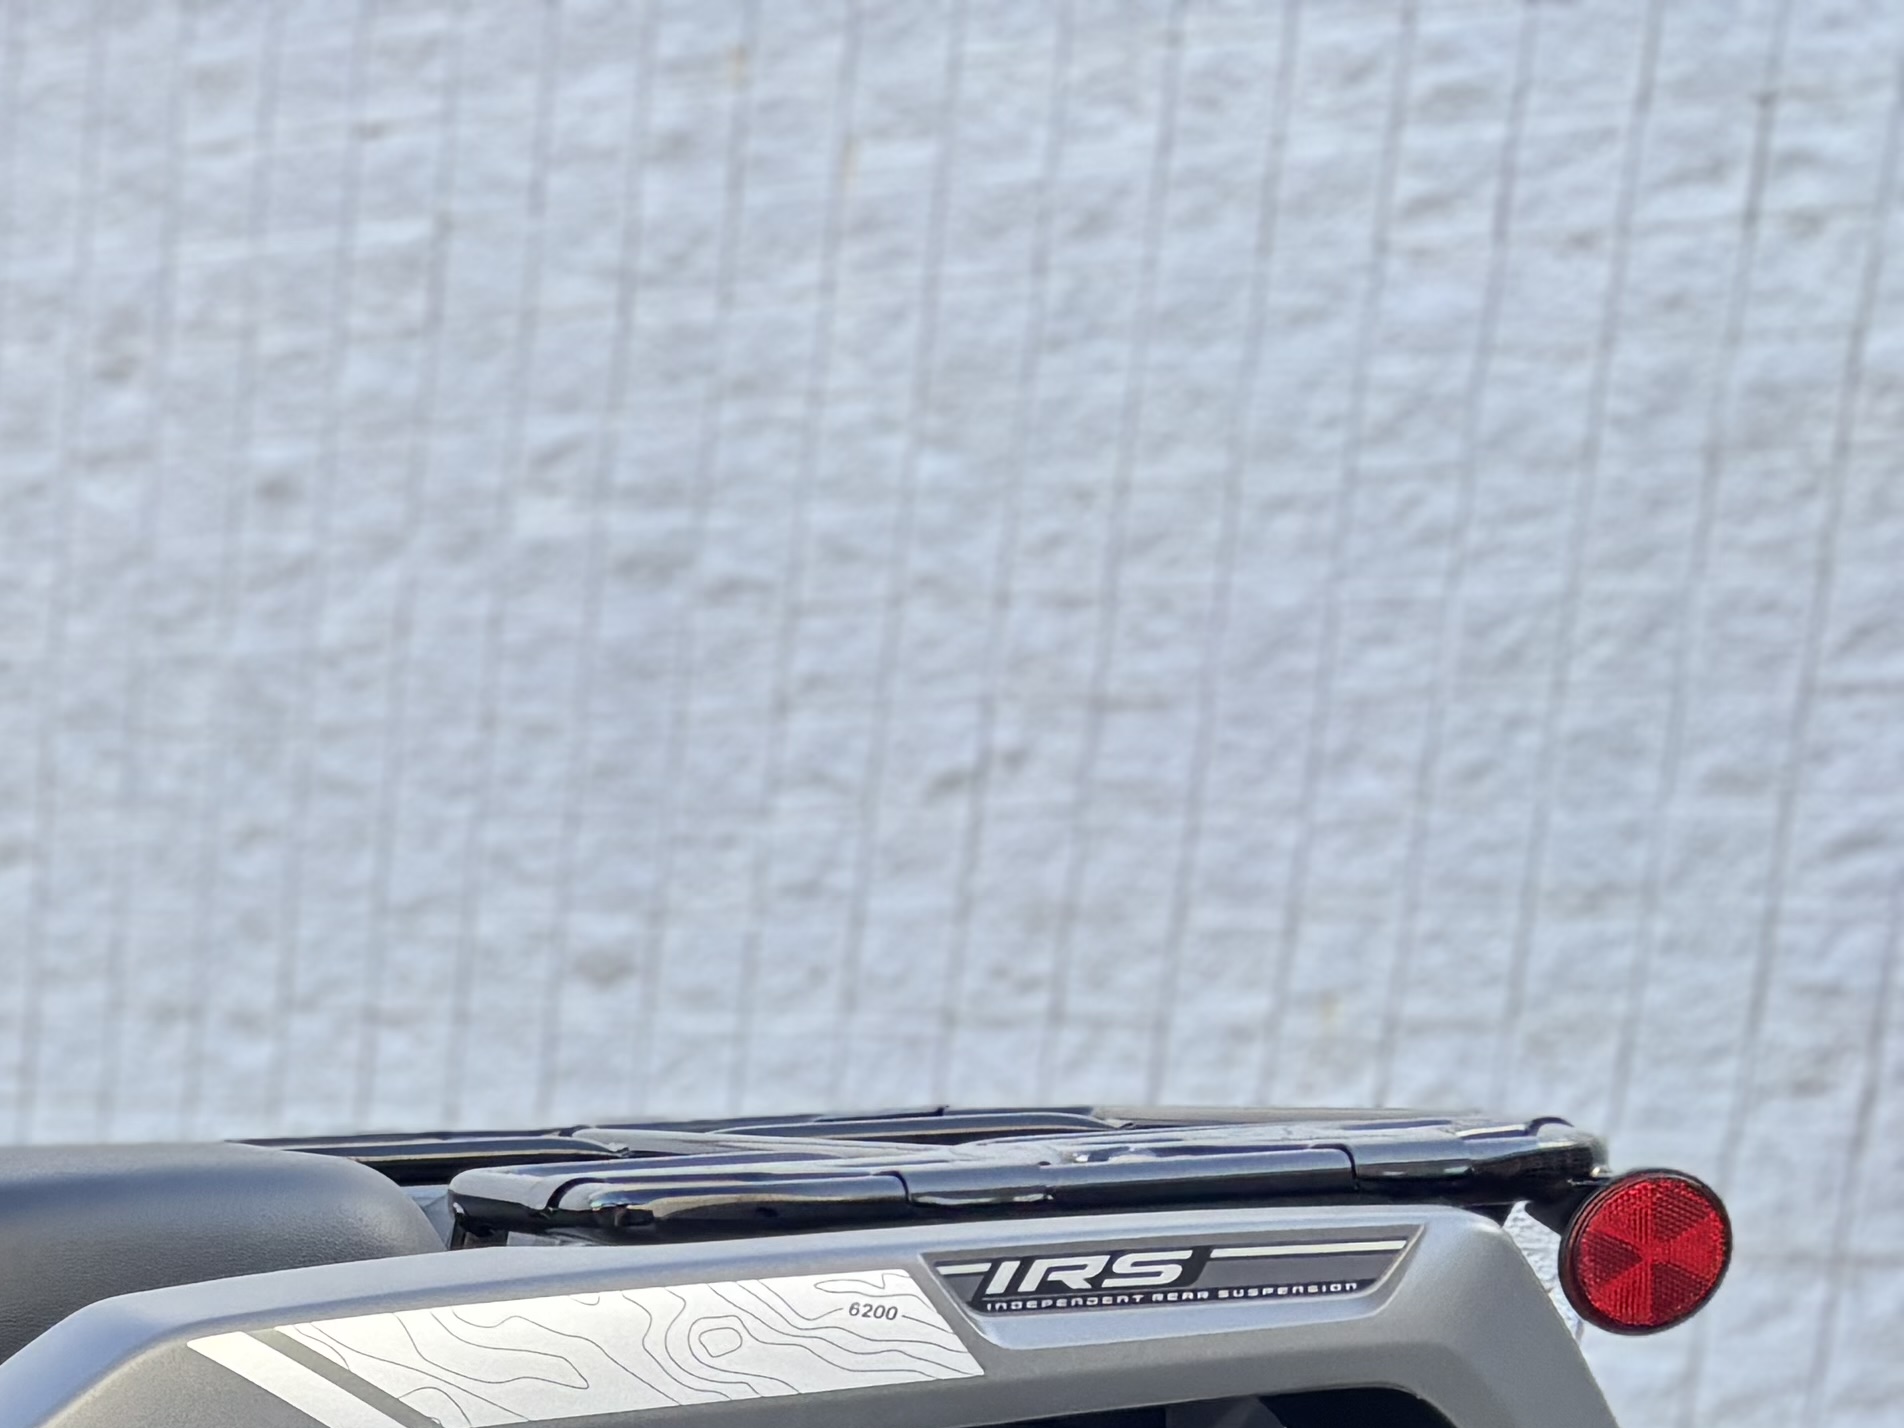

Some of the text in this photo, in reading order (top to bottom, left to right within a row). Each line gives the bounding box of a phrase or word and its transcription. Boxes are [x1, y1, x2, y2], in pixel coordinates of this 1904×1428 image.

[984, 1249, 1193, 1297] IRS
[847, 1301, 899, 1322] 6200
[986, 1282, 1359, 1312] INDEPENDENT REAR SUSPENSION
